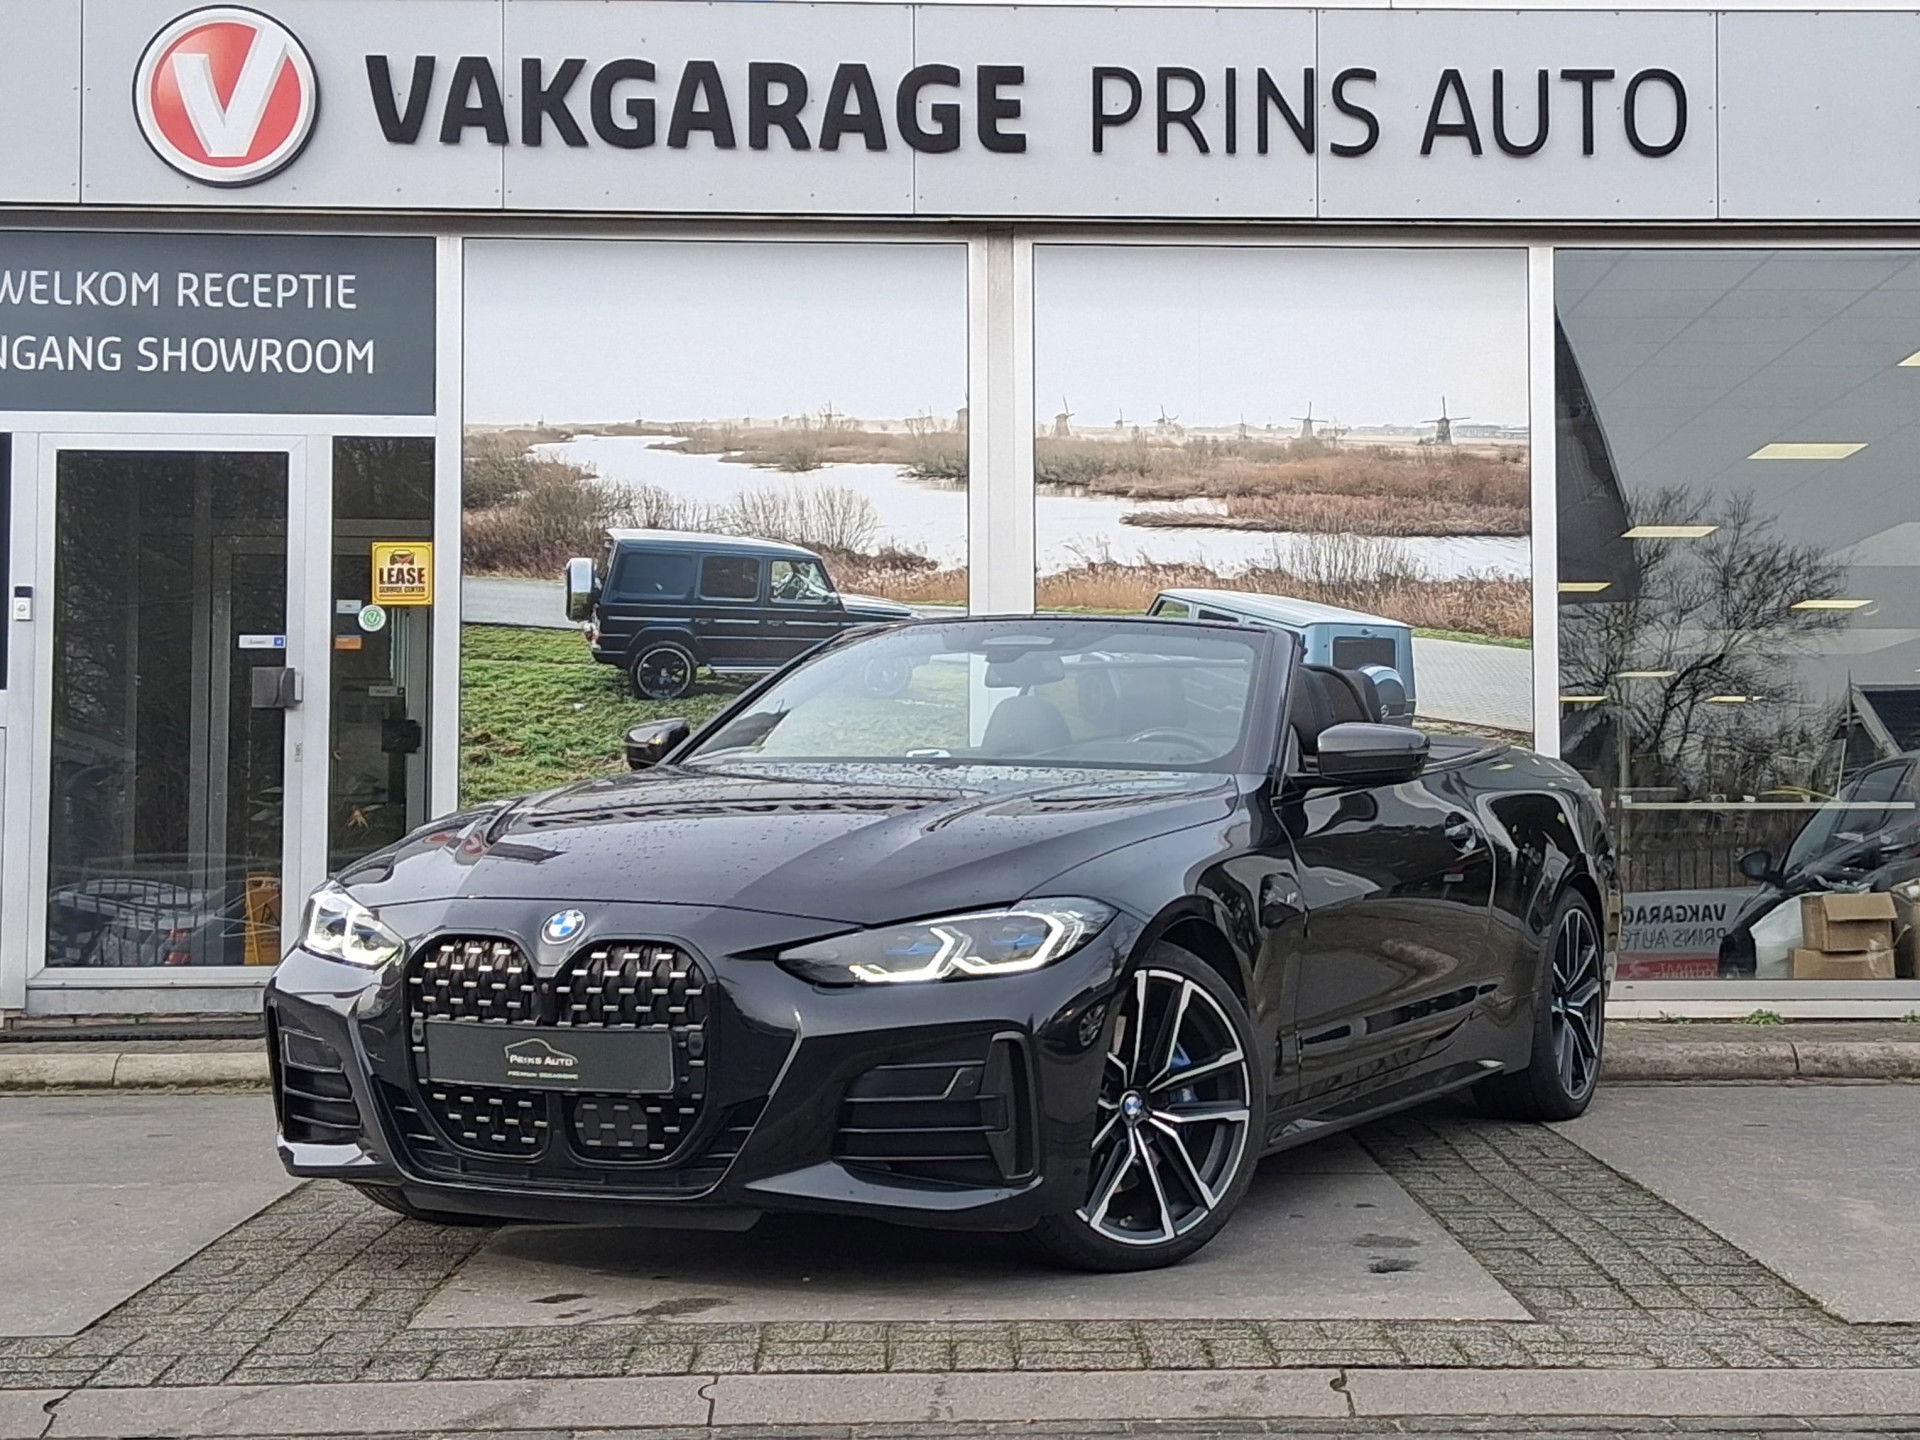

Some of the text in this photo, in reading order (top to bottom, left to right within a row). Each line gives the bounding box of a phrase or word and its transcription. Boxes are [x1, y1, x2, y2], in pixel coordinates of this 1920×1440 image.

[365, 54, 1688, 159] VAKGARAGE PRINS AUTO
[0, 270, 357, 309] WELKOM RECEPTIE
[136, 337, 374, 374] SHOWROOM
[379, 567, 425, 584] LEASE
